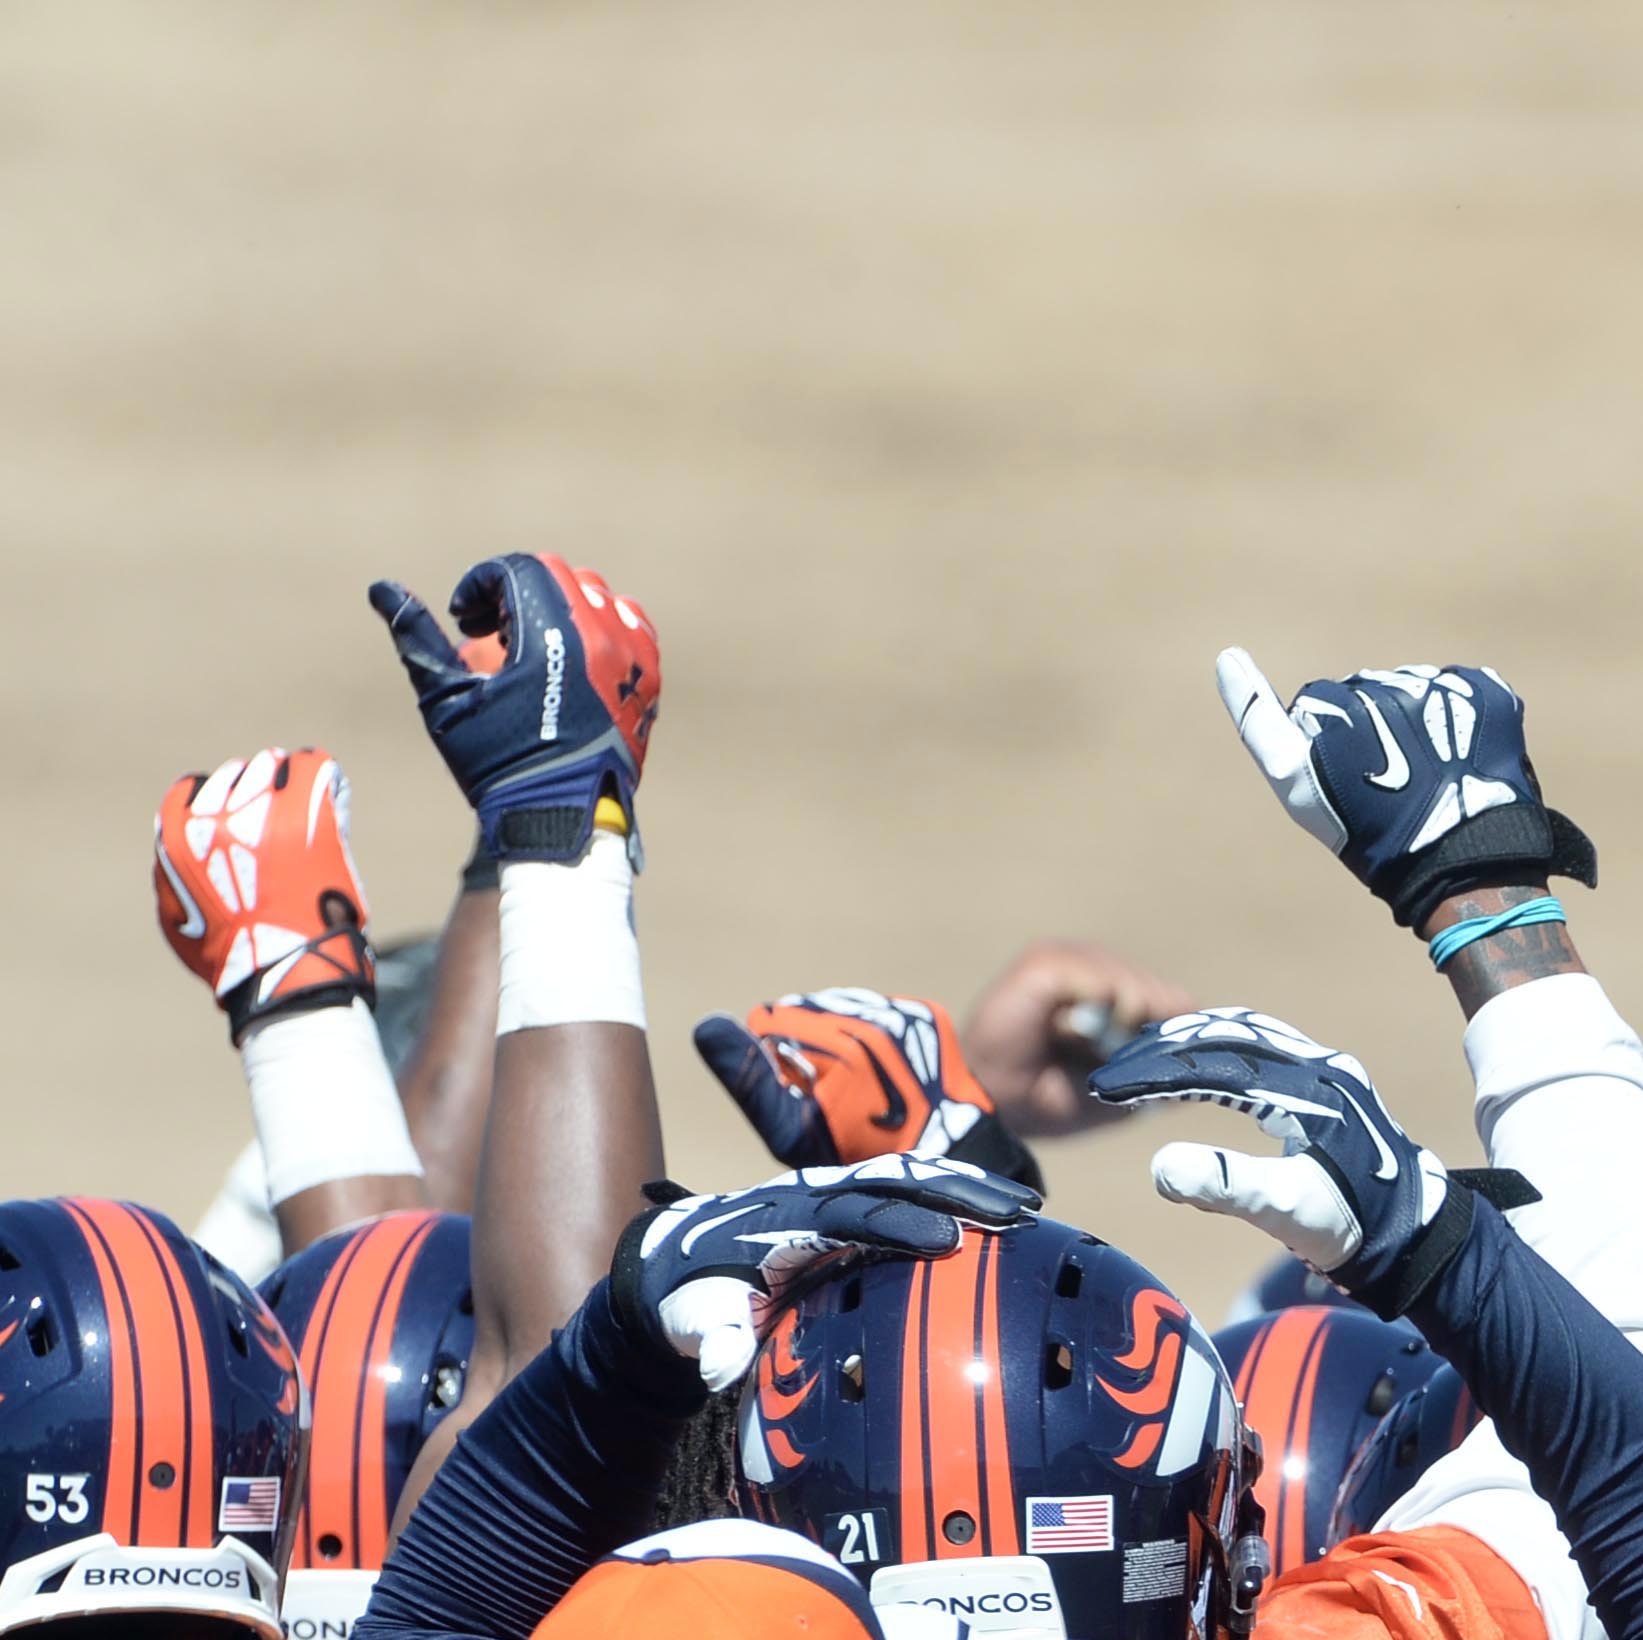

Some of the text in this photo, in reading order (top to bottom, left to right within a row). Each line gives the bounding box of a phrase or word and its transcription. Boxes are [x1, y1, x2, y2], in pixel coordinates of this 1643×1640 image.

[541, 628, 565, 740] BRONCOS
[26, 1473, 90, 1523] 53
[837, 1512, 880, 1564] 21
[84, 1566, 242, 1589] BRONCOS
